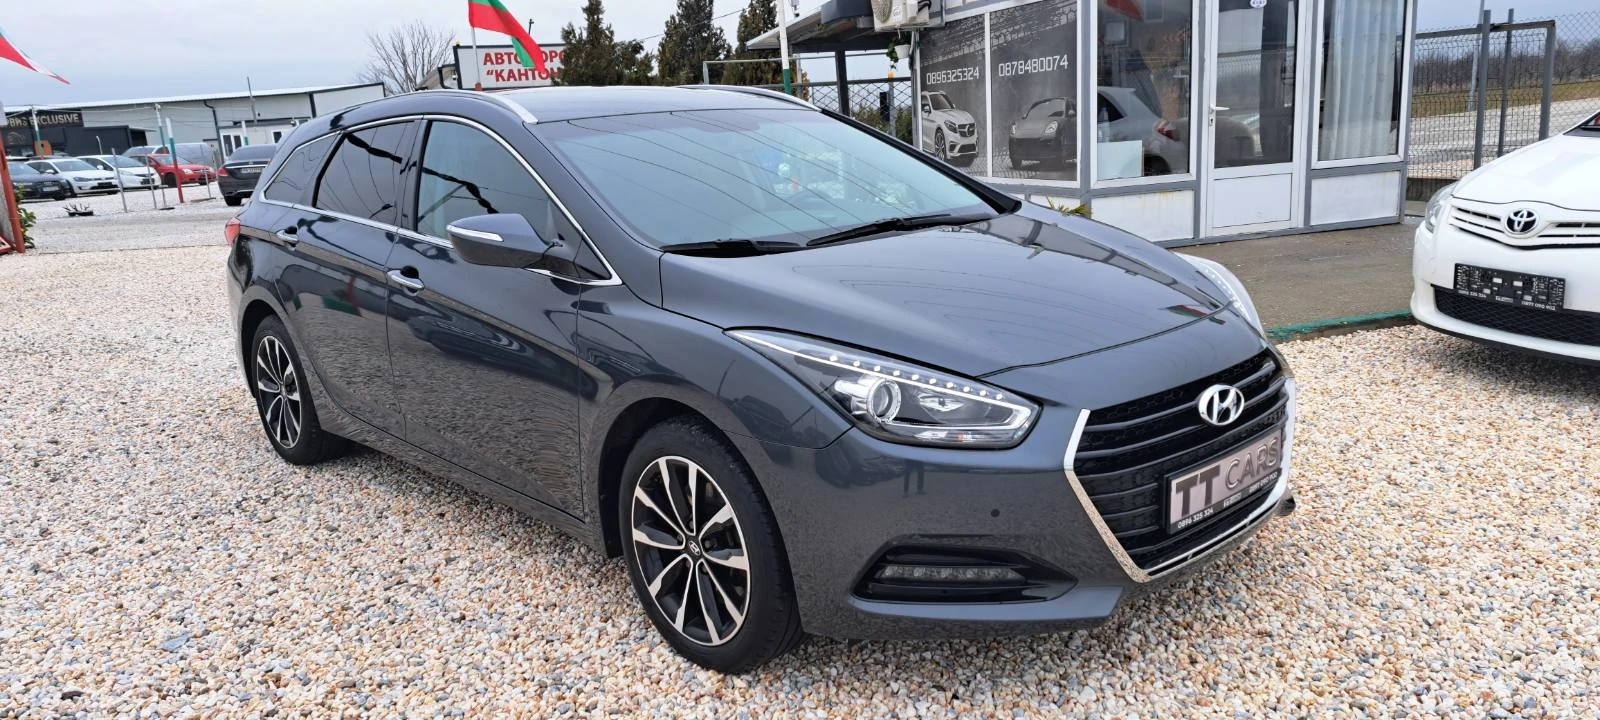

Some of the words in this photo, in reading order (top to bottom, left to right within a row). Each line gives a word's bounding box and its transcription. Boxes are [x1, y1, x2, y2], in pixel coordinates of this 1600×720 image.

[926, 67, 980, 85] 0896325324
[998, 54, 1069, 77] 0878480074
[1176, 464, 1221, 518] TT
[1224, 436, 1280, 490] CARS
